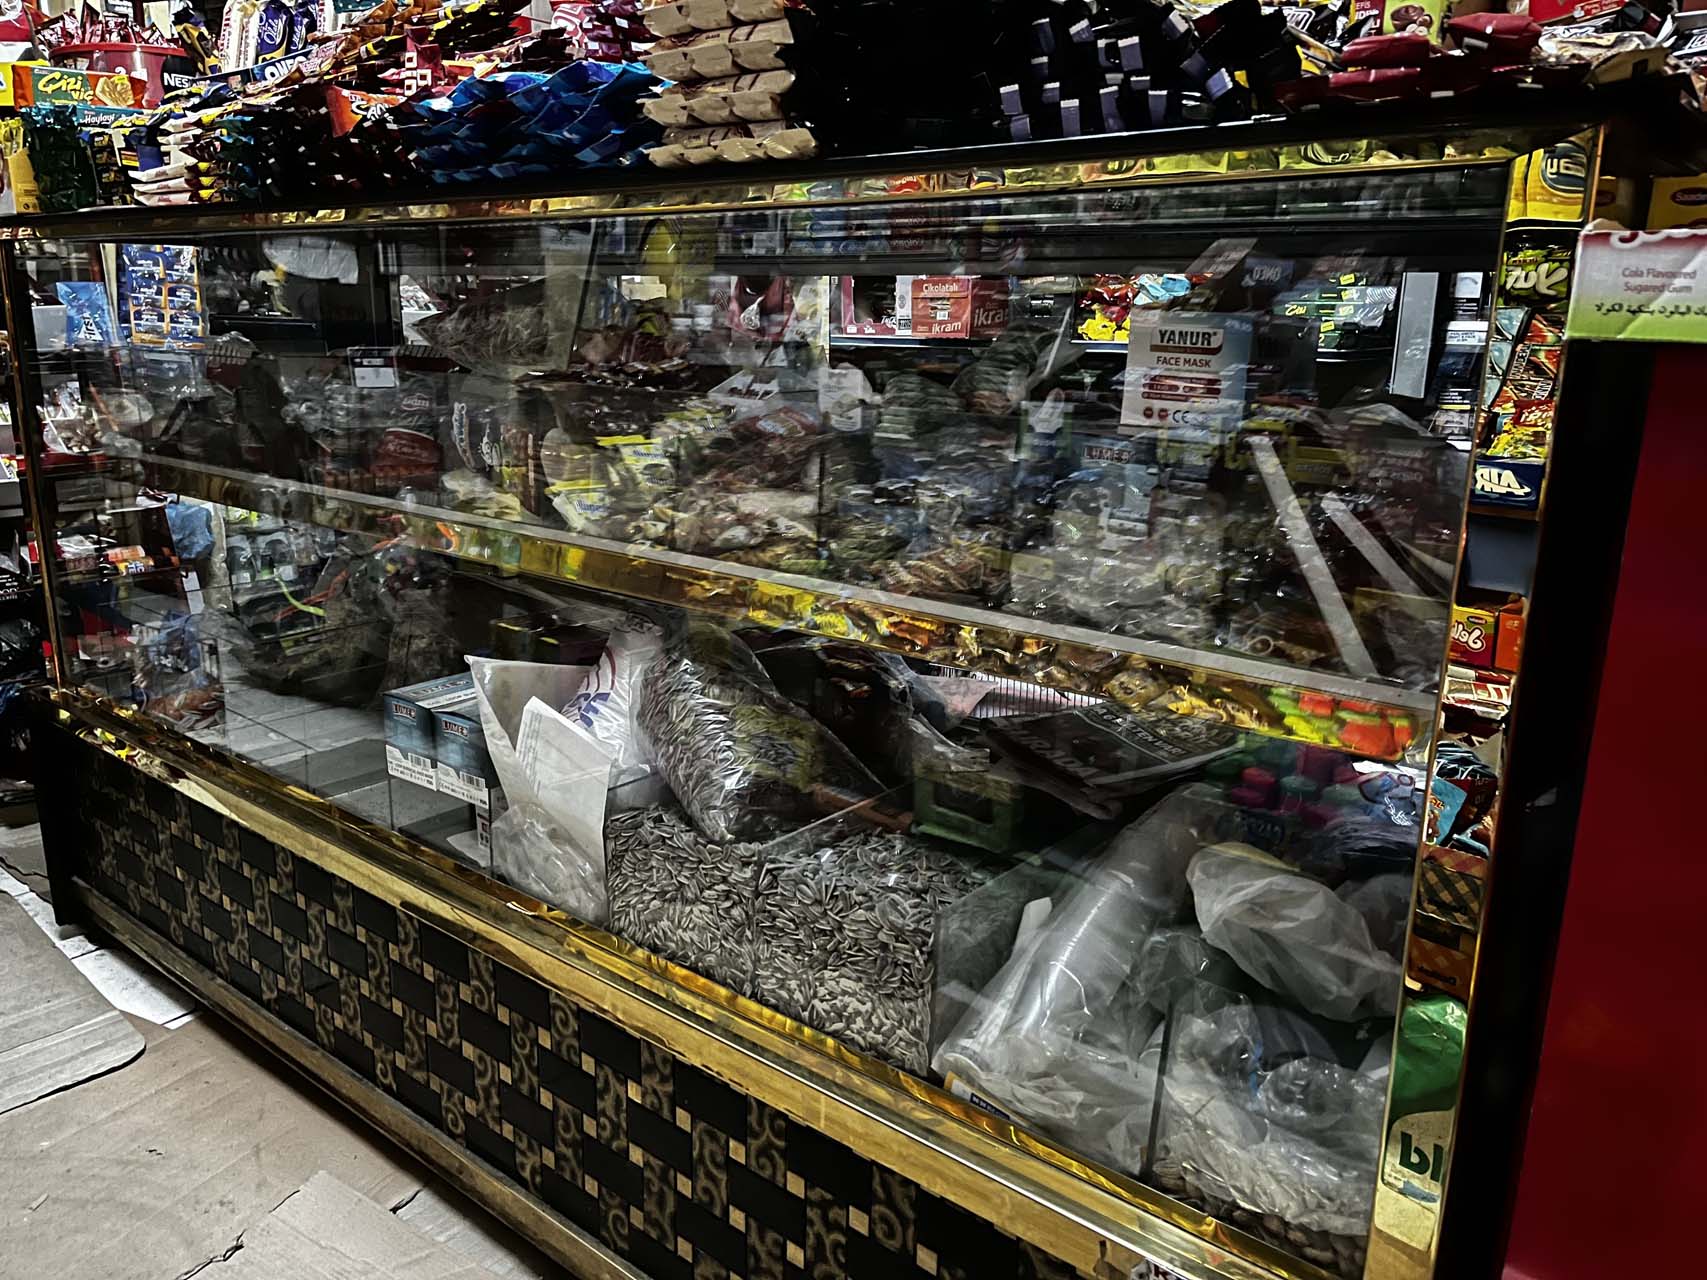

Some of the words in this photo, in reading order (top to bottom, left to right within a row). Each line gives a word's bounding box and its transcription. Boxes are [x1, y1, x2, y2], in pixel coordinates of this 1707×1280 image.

[1621, 267, 1644, 278] Cola
[931, 320, 962, 334] ikram
[1158, 329, 1212, 346] YANUR
[1156, 356, 1180, 366] FACE
[1182, 357, 1211, 368] MASK
